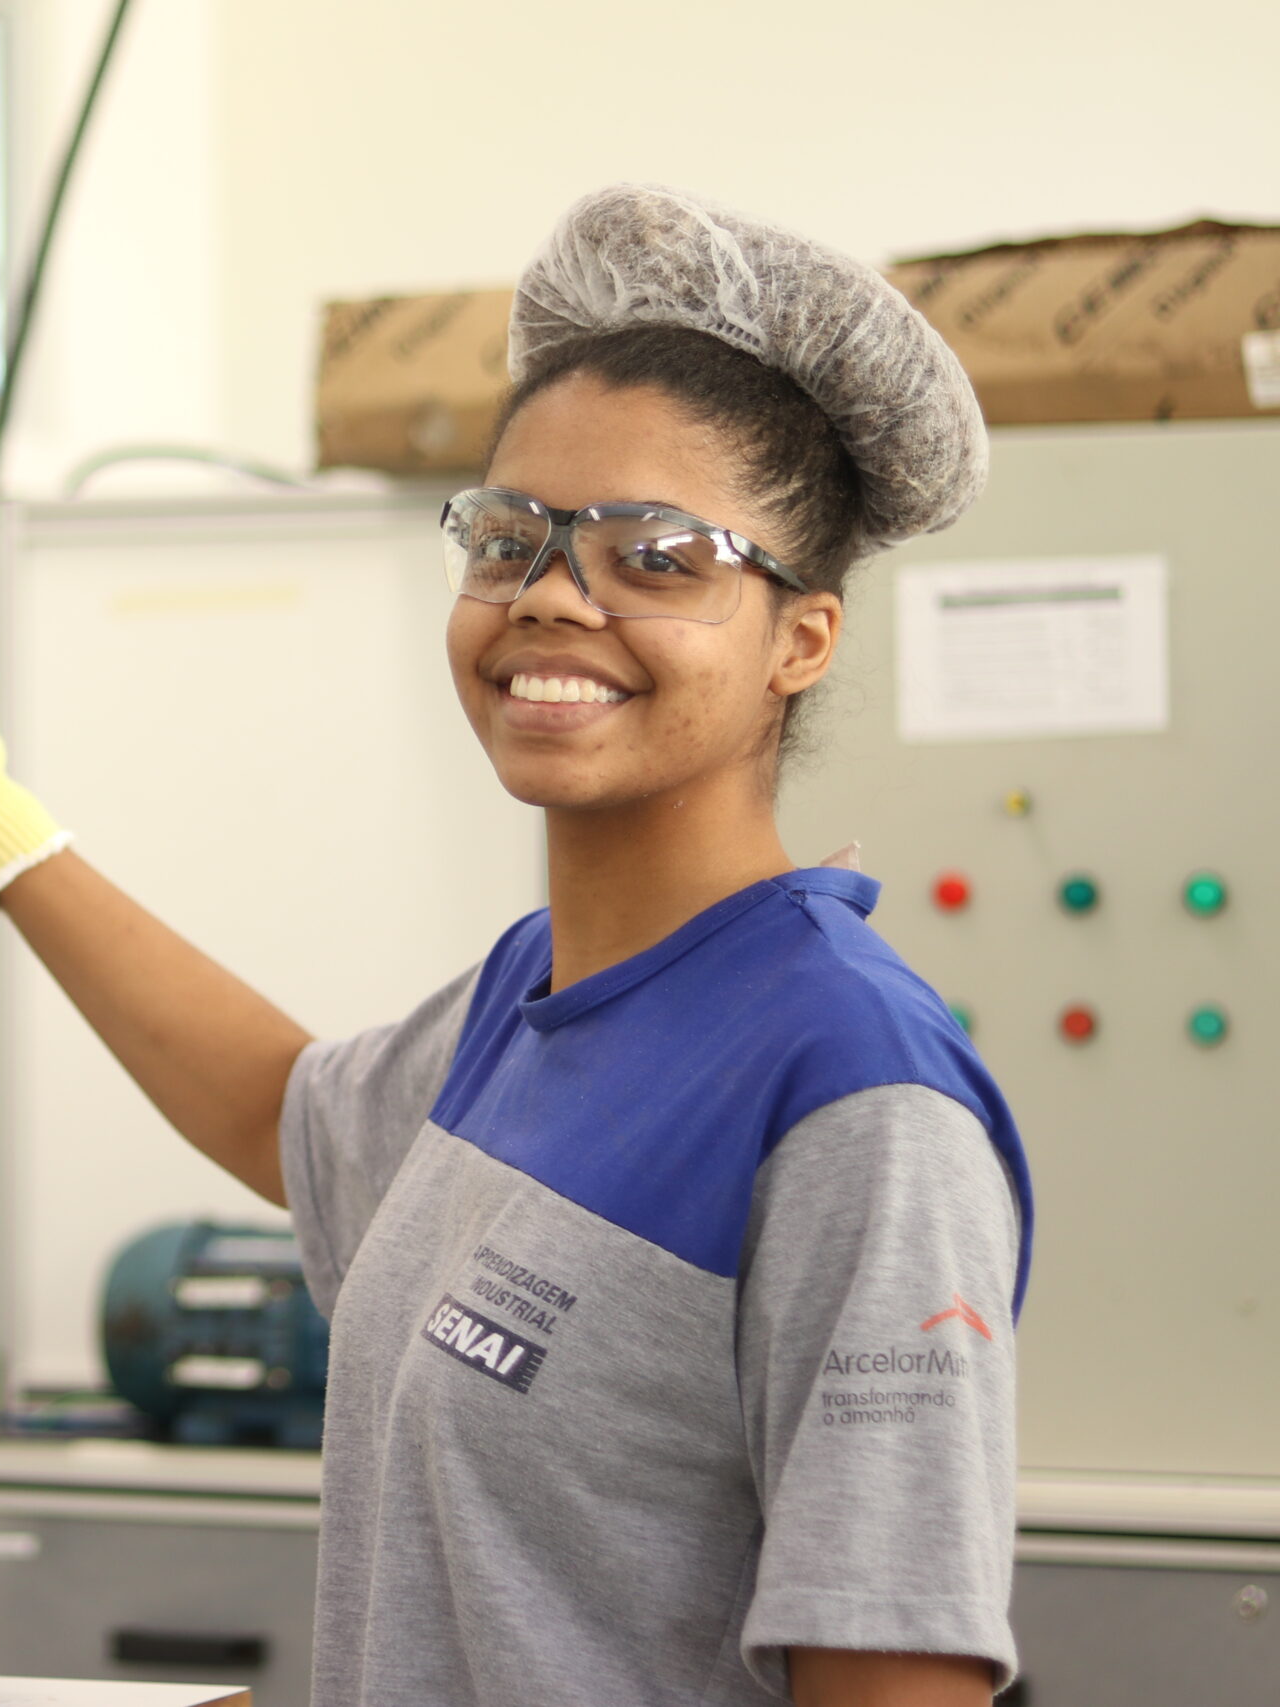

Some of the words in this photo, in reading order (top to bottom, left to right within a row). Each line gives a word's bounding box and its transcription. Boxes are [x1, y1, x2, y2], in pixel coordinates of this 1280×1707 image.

[426, 1303, 525, 1375] SENAI
[822, 1387, 956, 1408] transformando
[823, 1412, 835, 1426] o
